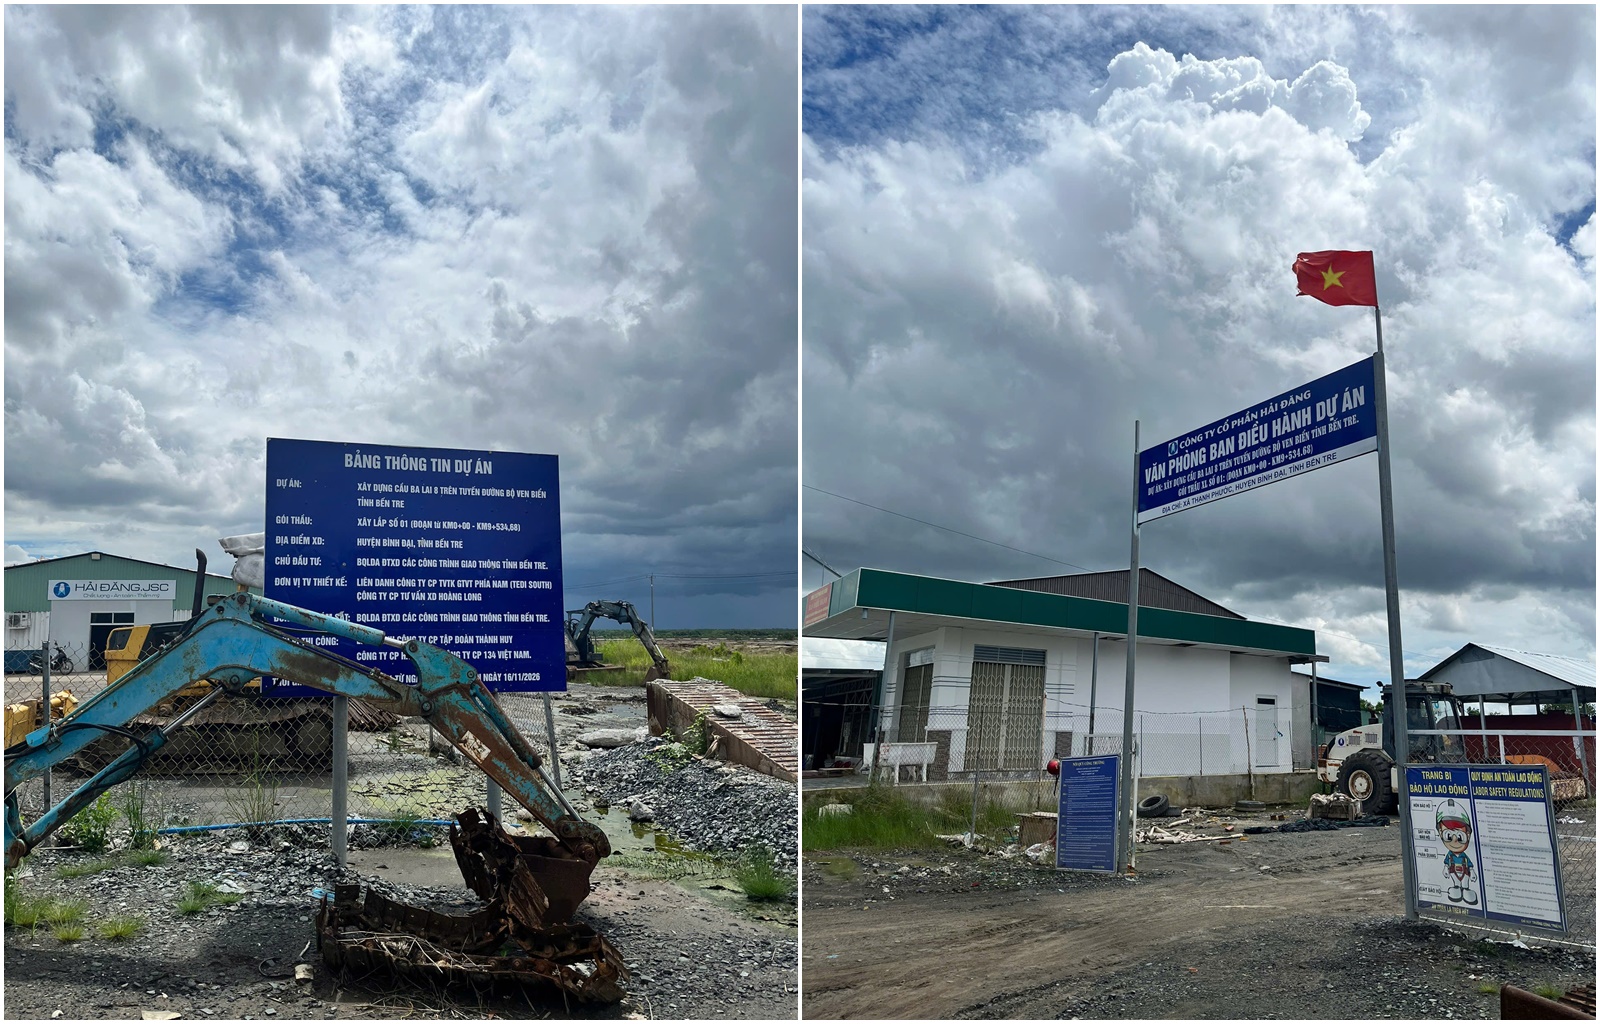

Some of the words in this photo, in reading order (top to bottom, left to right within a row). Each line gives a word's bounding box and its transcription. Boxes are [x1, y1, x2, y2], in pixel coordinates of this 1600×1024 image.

[1180, 434, 1202, 449] CÔNG
[1205, 429, 1215, 439] TY
[1217, 418, 1229, 434] CỔ
[1232, 411, 1257, 429] PHẦN
[1261, 403, 1278, 417] HẢI
[1280, 390, 1311, 409] ĐĂNG
[1145, 462, 1165, 484] VĂN
[1169, 447, 1206, 476] PHÒNG
[1210, 436, 1234, 461] BAN
[1238, 421, 1268, 450] ĐIỀU
[1272, 406, 1311, 438] HÀNH
[1316, 394, 1338, 422] DỰ
[1342, 386, 1365, 412] ÁN
[344, 450, 380, 469] BẢNG
[385, 454, 426, 472] THÔNG
[431, 458, 451, 472] TIN
[455, 459, 472, 476] DỰ
[474, 458, 492, 474] ÁN
[276, 478, 288, 489] DỰ
[289, 478, 302, 488] ÁN:
[1192, 494, 1210, 504] THẠNH
[1211, 486, 1234, 498] PHƯỚC,
[1235, 480, 1256, 491] HUYỆN
[1258, 474, 1272, 484] BÌNH
[1274, 469, 1287, 480] ĐẠI,
[1289, 463, 1304, 474] TỈNH
[1306, 456, 1320, 468] BẾN
[1323, 452, 1336, 463] TRE
[357, 482, 371, 491] XÂY
[373, 483, 393, 493] DỰNG
[394, 482, 408, 493] CẦU
[440, 485, 457, 495] TRÊN
[459, 486, 480, 496] TUYẾN
[482, 487, 504, 497] ĐƯỜNG
[506, 488, 515, 499] BỘ
[516, 490, 529, 498] VEN
[530, 488, 546, 498] BIỂN
[357, 496, 374, 507] TỈNH
[375, 497, 390, 508] BẾN
[392, 500, 404, 508] TRE
[276, 514, 288, 524] GÓI
[291, 514, 312, 525] THẦU:
[357, 517, 372, 527] XÂY
[374, 516, 386, 527] LẮP
[389, 517, 398, 528] SỐ
[400, 520, 408, 528] 01
[410, 520, 432, 530] (ĐOẠN
[434, 520, 441, 528] từ
[442, 521, 470, 530] KM0+00
[476, 523, 520, 532] KM9+534,68)
[276, 536, 289, 546] ĐỊA
[291, 534, 310, 545] ĐIỂM
[312, 537, 324, 545] XD:
[357, 537, 381, 548] HUYỆN
[382, 537, 400, 547] BÌNH
[401, 539, 415, 549] ĐẠI,
[417, 537, 433, 548] TỈNH
[435, 538, 449, 548] BẾN
[451, 540, 463, 549] TRE
[275, 554, 290, 565] CHỦ
[292, 554, 308, 566] ĐẦU
[310, 557, 322, 566] TƯ:
[357, 558, 380, 568] BQLDA
[382, 558, 400, 567] ĐTXD
[402, 557, 416, 567] CÁC
[418, 558, 437, 568] CÔNG
[439, 558, 459, 568] TRÌNH
[461, 560, 476, 568] GIAO
[479, 559, 501, 569] THÔNG
[502, 559, 517, 569] TỈNH
[519, 559, 532, 569] BẾN
[534, 561, 548, 570] TRE.
[75, 582, 97, 591] HẢI
[100, 582, 169, 592] ĐĂNG.JSC
[275, 577, 290, 586] ĐƠN
[293, 577, 301, 588] VỊ
[302, 578, 312, 586] TV
[313, 576, 334, 587] THIẾT
[335, 576, 348, 587] KẾ:
[357, 577, 373, 587] LIÊN
[375, 578, 394, 587] DANH
[396, 577, 416, 587] CÔNG
[428, 579, 437, 588] CP
[457, 580, 473, 588] GTVT
[475, 578, 490, 588] PHÍA
[510, 581, 527, 590] (TEDI
[528, 581, 552, 590] SOUTH)
[357, 590, 376, 601] CÔNG
[389, 592, 398, 600] CP
[401, 592, 410, 600] TƯ
[411, 590, 425, 600] VẤN
[439, 591, 462, 601] HOÀNG
[464, 593, 482, 601] LONG
[357, 614, 380, 623] BQLDA
[382, 614, 400, 622] ĐTXD
[402, 612, 416, 622] CÁC
[419, 612, 438, 622] CÔNG
[440, 612, 460, 622] TRÌNH
[462, 614, 478, 622] GIAO
[480, 612, 502, 622] THÔNG
[503, 612, 519, 622] TỈNH
[520, 612, 534, 622] BẾN
[536, 614, 550, 622] TRE.
[315, 636, 339, 646] CÔNG:
[428, 636, 438, 644] CP
[440, 634, 453, 646] TẬP
[455, 634, 474, 644] ĐOÀN
[476, 634, 498, 644] THÀNH
[357, 650, 377, 660] CÔNG
[389, 652, 399, 660] CP
[463, 650, 470, 659] TY
[472, 650, 482, 659] CP
[484, 650, 496, 659] 134
[497, 649, 512, 660] VIỆT
[514, 651, 531, 659] NAM.
[483, 672, 501, 682] NGÀY
[504, 673, 540, 682] 16/11/2026
[1422, 771, 1443, 780] TRANG
[1445, 771, 1452, 782] BỊ
[1471, 771, 1480, 781] QUY
[1482, 772, 1493, 783] ĐỊNH
[1494, 772, 1501, 781] AN
[1502, 771, 1515, 782] TOÀN
[1516, 773, 1526, 782] LAO
[1527, 771, 1542, 784] ĐỘNG
[1410, 782, 1423, 792] BẢO
[1424, 783, 1432, 795] HỘ
[1434, 785, 1447, 793] LAO
[1448, 784, 1468, 795] ĐỘNG
[1473, 787, 1488, 796] LABOR
[1490, 787, 1507, 796] SAFETY
[1508, 788, 1544, 798] REGULATIONS
